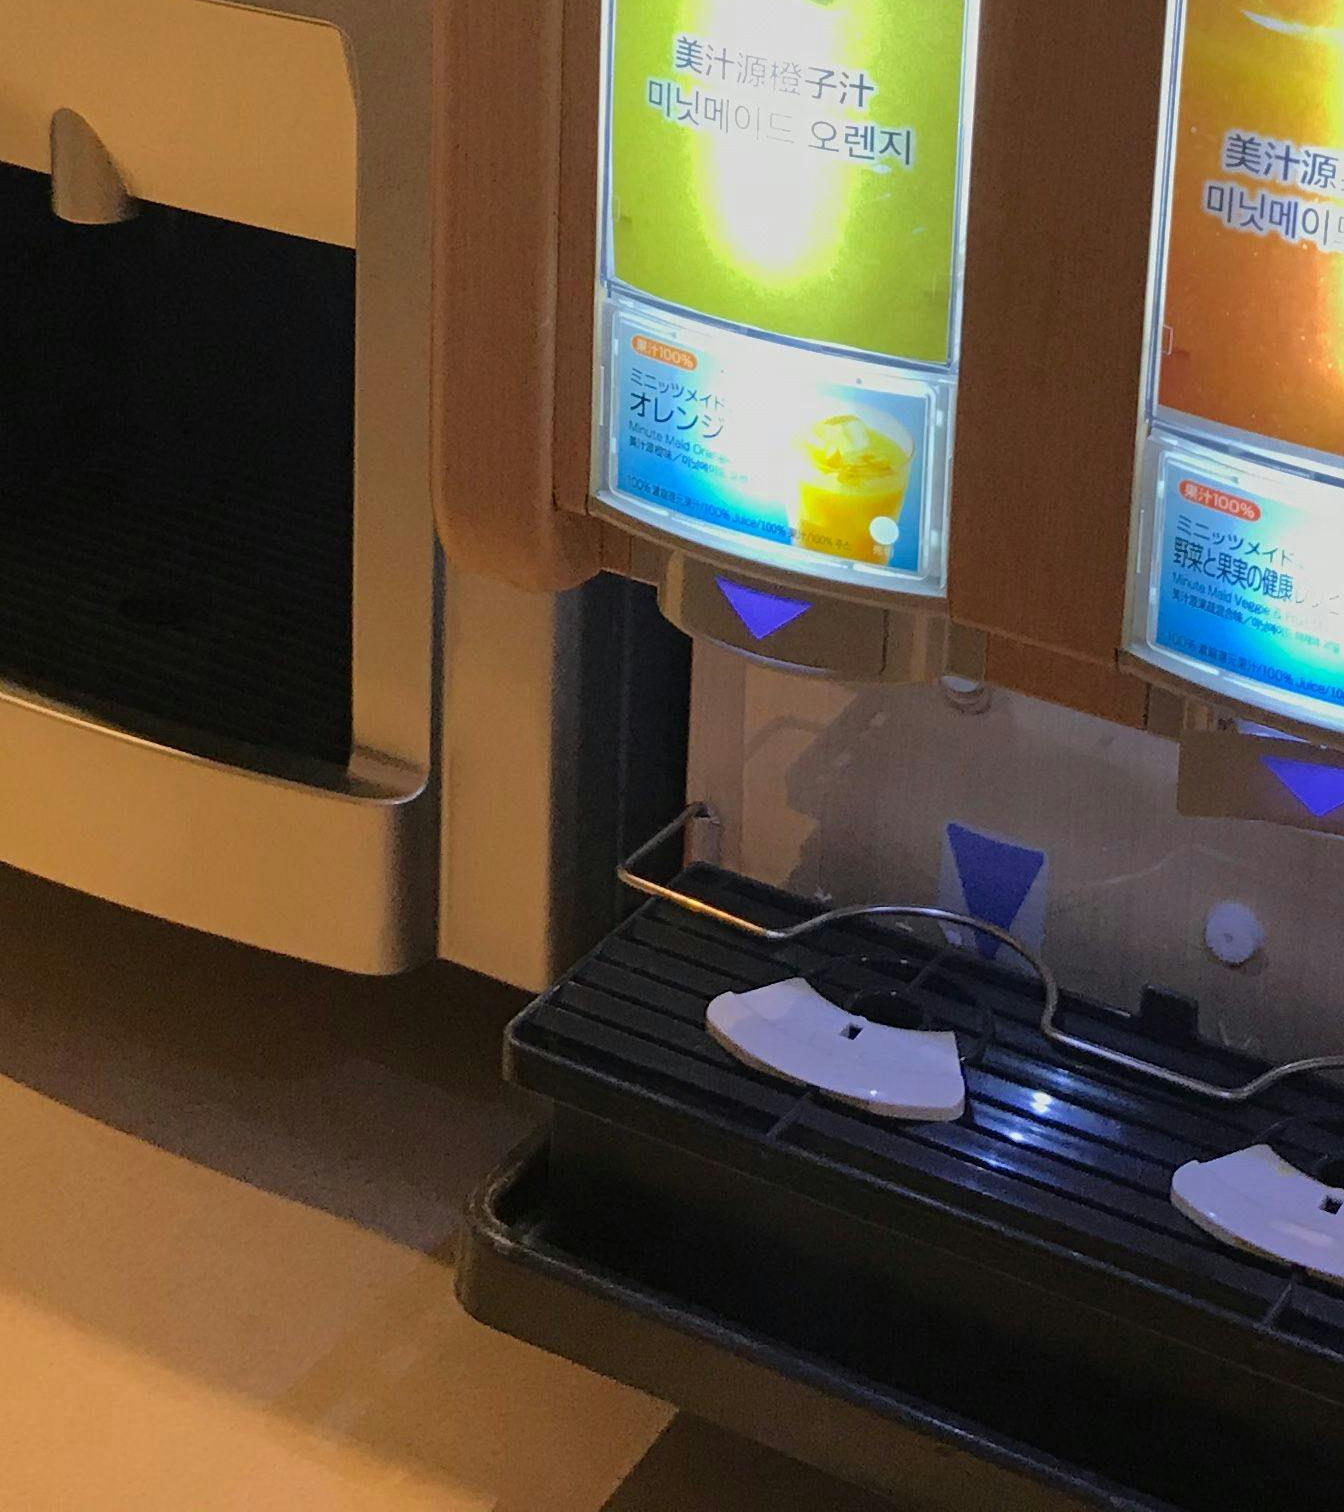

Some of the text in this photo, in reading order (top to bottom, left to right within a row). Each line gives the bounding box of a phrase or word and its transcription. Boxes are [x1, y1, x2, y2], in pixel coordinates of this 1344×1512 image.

[674, 34, 876, 109] 美汁源橙子汁
[647, 80, 913, 166] 미닛메이드 오렌지
[629, 391, 725, 439] オレンジ
[1184, 484, 1257, 521] 果汁100%
